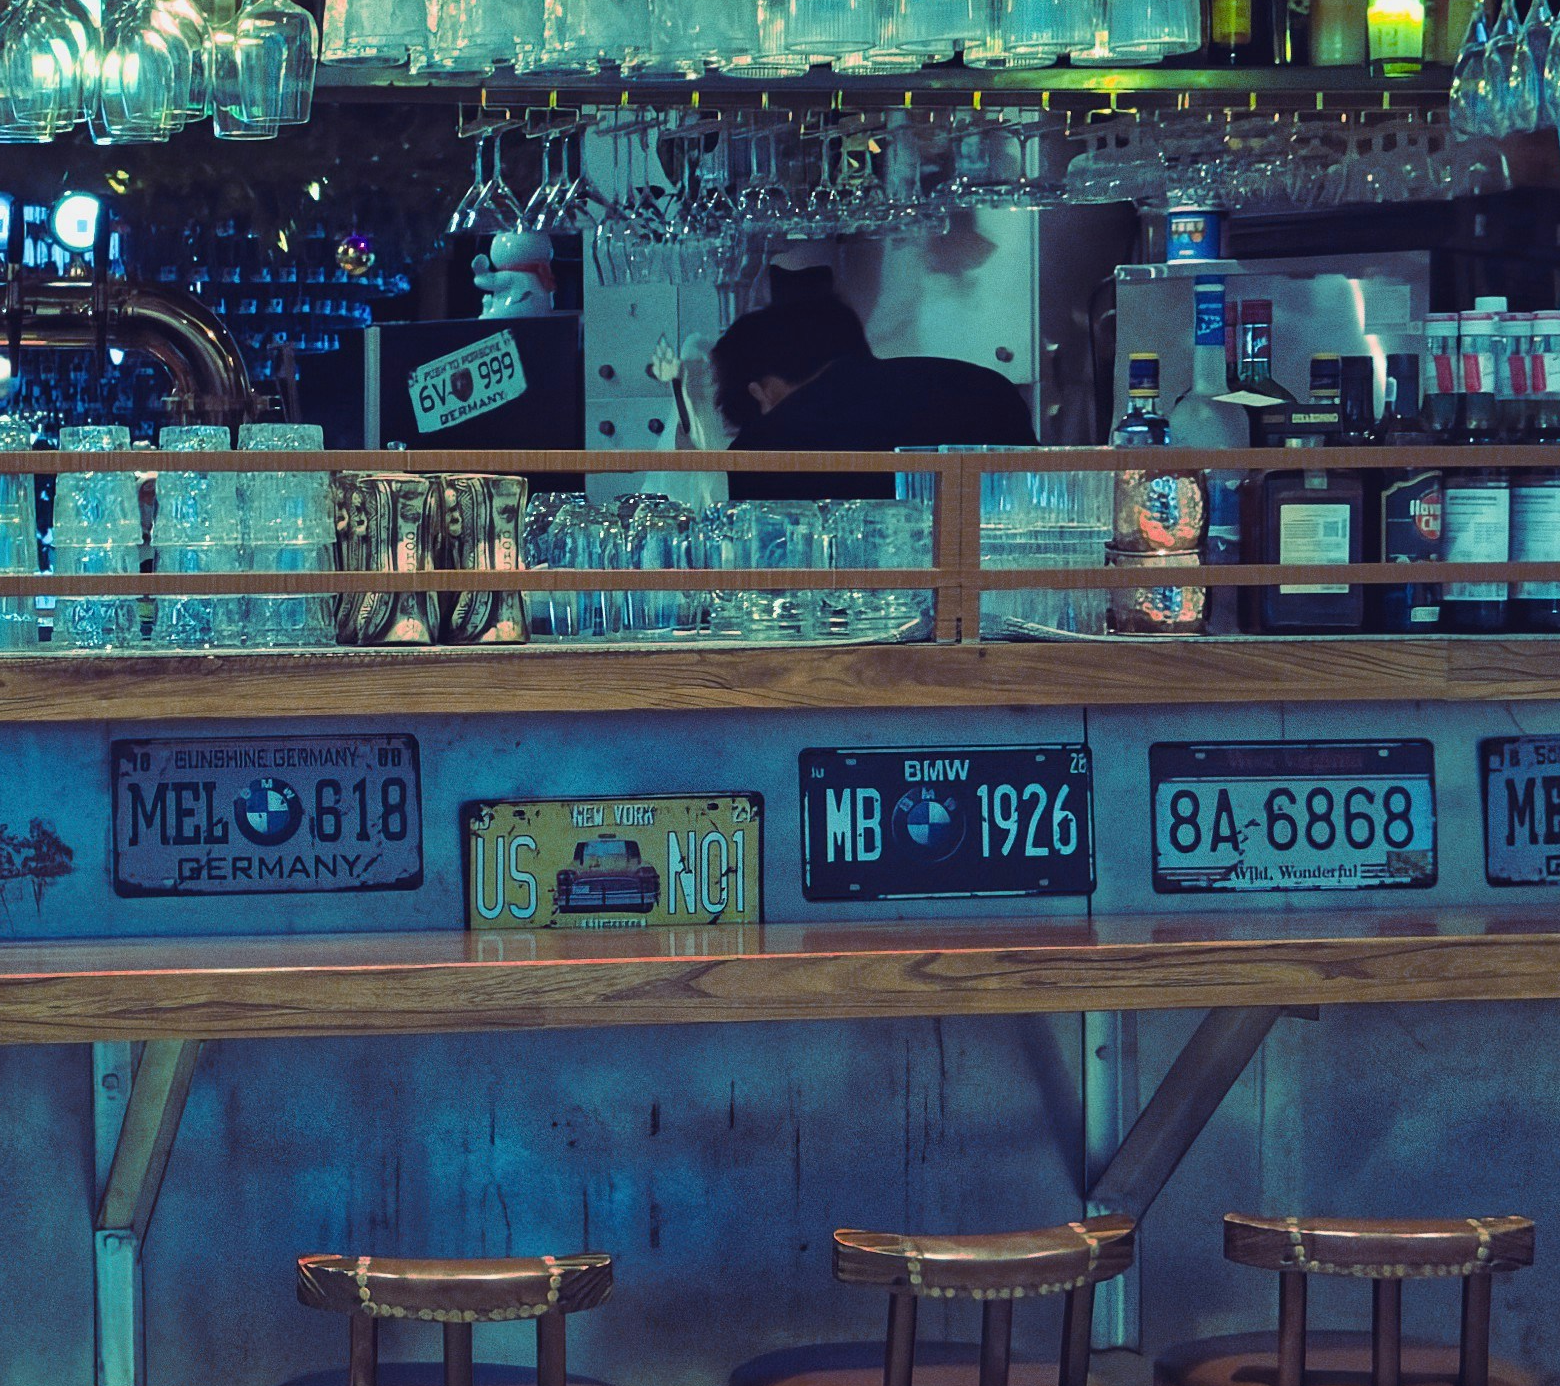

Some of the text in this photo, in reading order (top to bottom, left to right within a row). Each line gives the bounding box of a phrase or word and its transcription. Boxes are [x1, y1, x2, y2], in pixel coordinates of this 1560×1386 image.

[478, 351, 515, 390] 999
[904, 759, 970, 782] BMW
[128, 781, 230, 847] MEL
[315, 776, 408, 843] 618
[572, 803, 656, 828] NEW YORK
[826, 783, 1078, 863] MB 1926
[177, 854, 363, 882] GERMANY
[475, 834, 538, 920] US
[1280, 863, 1357, 882] Wonderful
